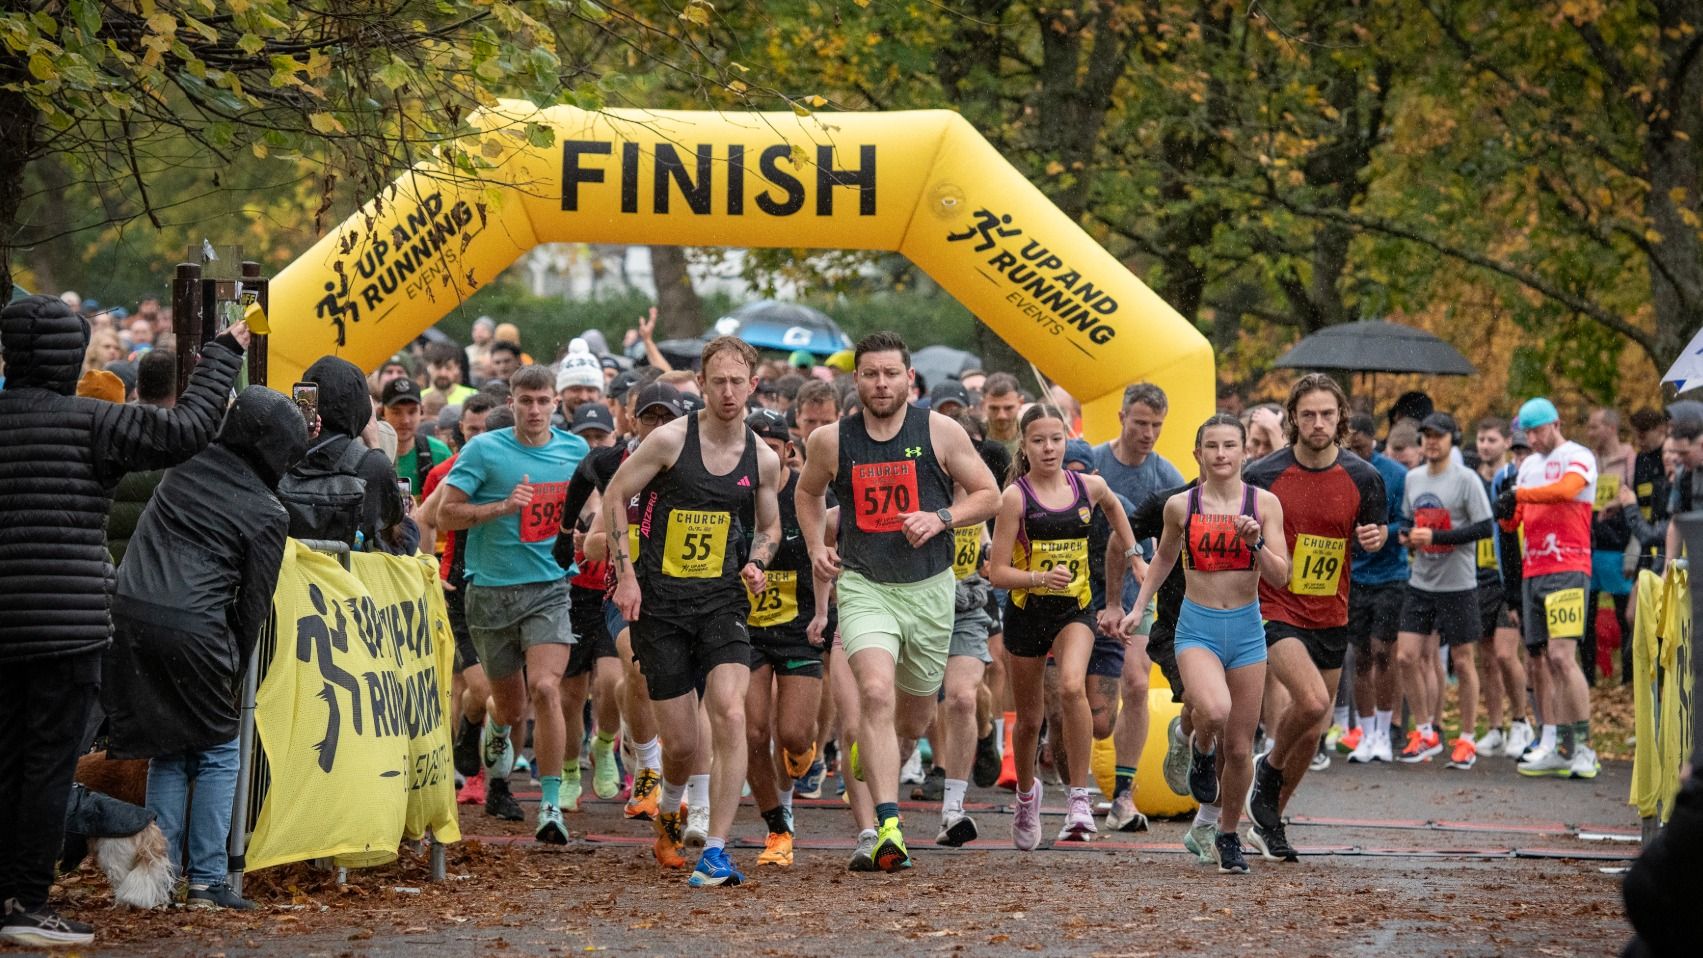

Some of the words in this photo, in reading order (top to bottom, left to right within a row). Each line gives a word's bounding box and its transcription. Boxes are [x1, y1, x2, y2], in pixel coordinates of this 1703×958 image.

[561, 139, 876, 216] FINISH
[354, 240, 389, 279] UP
[392, 191, 442, 251] AND
[360, 201, 472, 311] RUNNING
[405, 249, 457, 300] EVENTS
[1020, 238, 1063, 270] UP
[1053, 267, 1119, 316] AND
[988, 249, 1116, 345] RUNNING
[1005, 291, 1065, 336] EVENTS
[860, 464, 909, 478] CHURCH
[864, 484, 910, 516] 570
[530, 501, 565, 527] 593
[640, 491, 658, 539] ADIZERO
[676, 513, 725, 525] CHURCH
[681, 533, 713, 561] 55
[956, 541, 976, 567] 68
[1041, 541, 1083, 553] CHURCH
[1197, 532, 1242, 558] 444
[1303, 537, 1344, 550] CHURCH
[767, 571, 789, 582] RCH
[1039, 559, 1080, 582] 28
[1302, 555, 1339, 580] 149
[755, 587, 783, 612] 23
[1550, 606, 1582, 625] 5061
